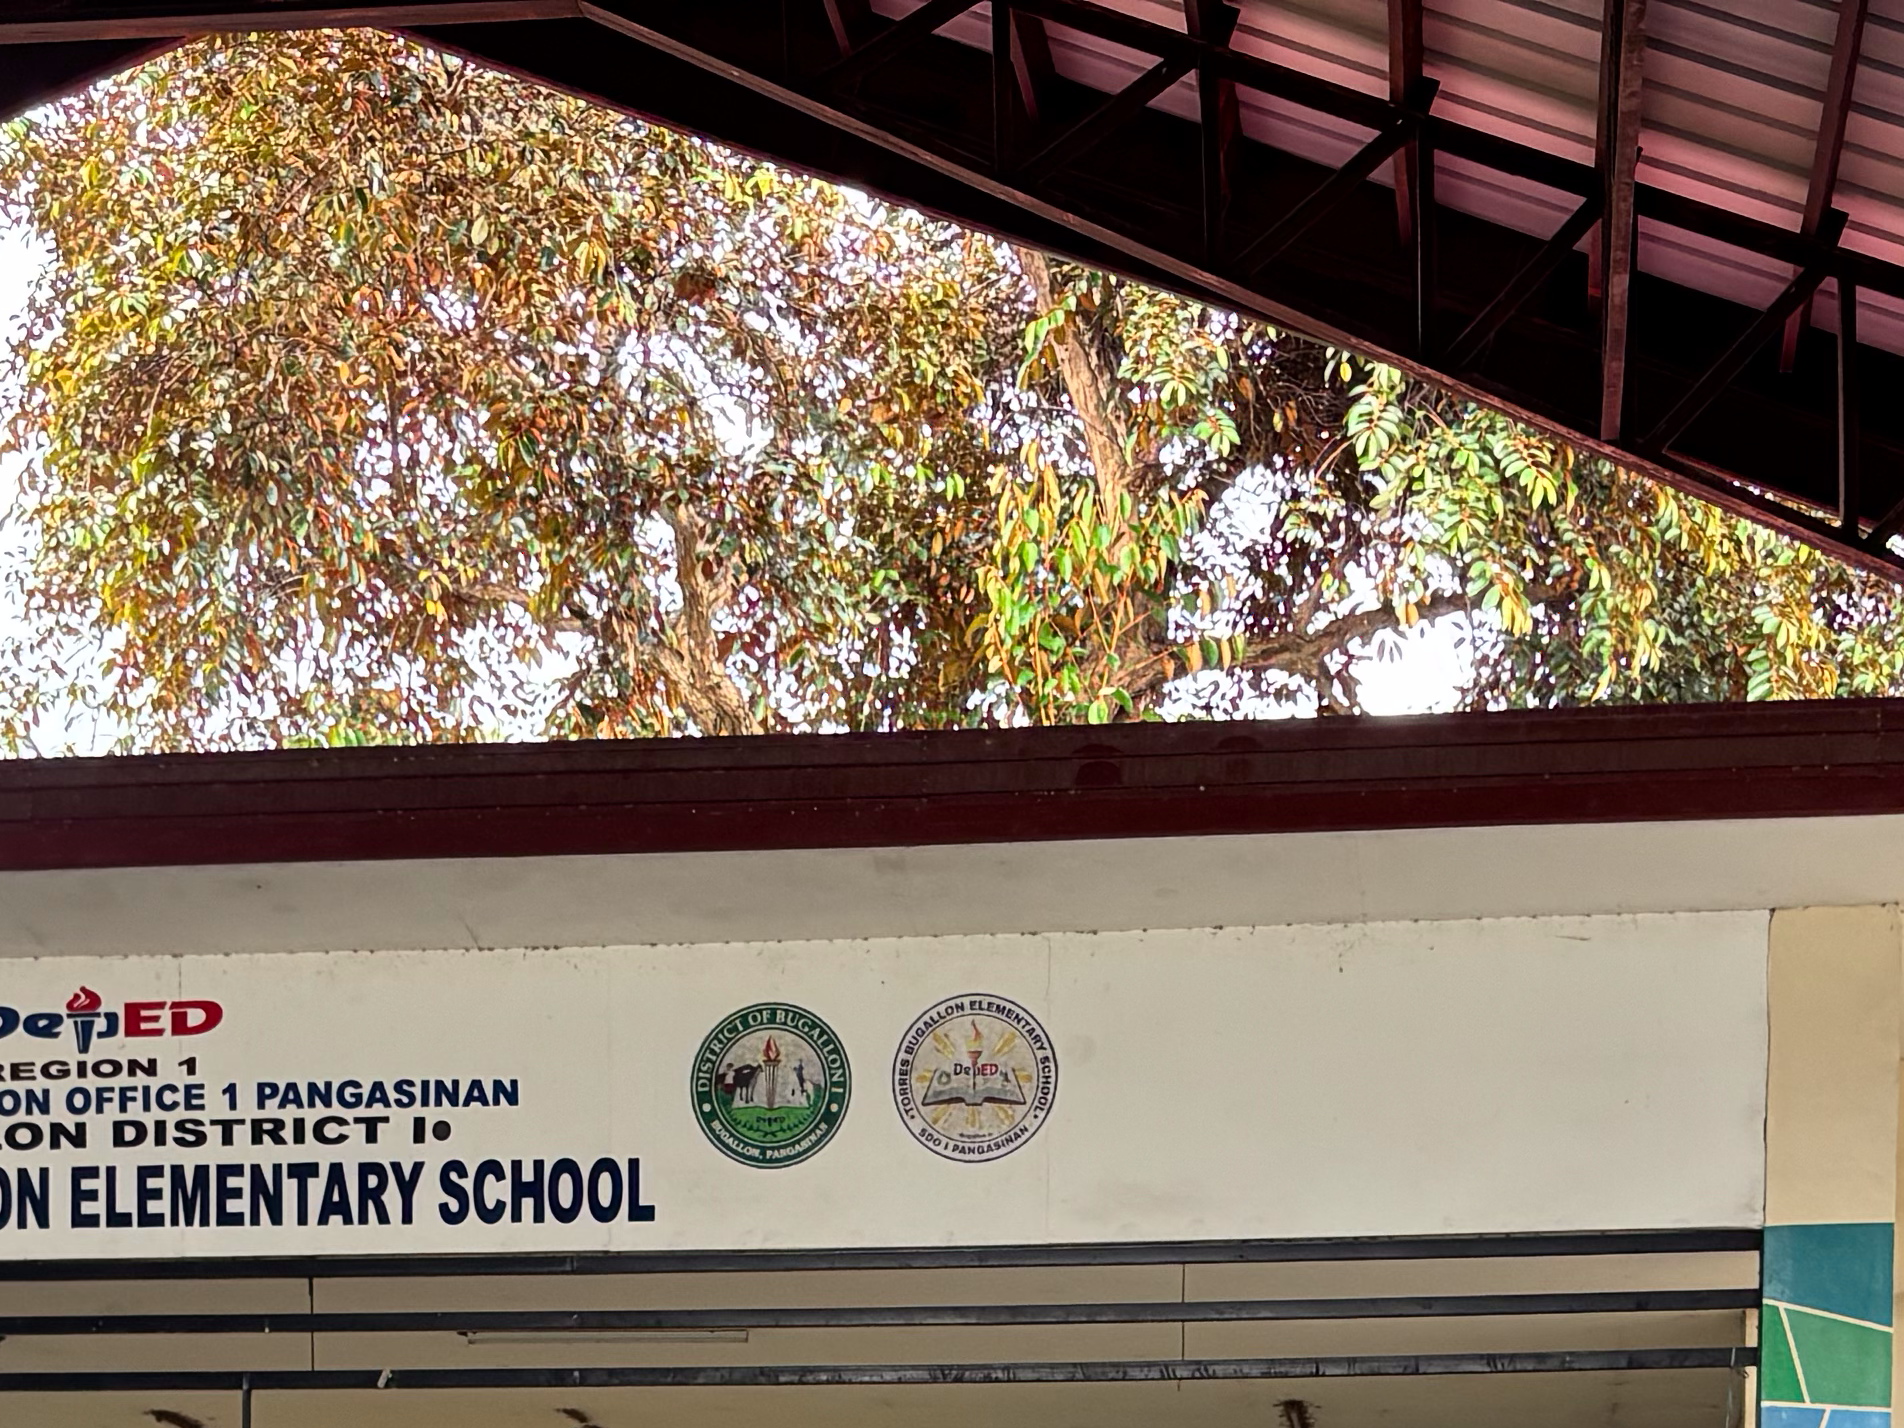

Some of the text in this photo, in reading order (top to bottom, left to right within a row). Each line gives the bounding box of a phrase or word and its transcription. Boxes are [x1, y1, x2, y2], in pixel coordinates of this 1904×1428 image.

[178, 1056, 197, 1077] 1
[697, 1018, 744, 1092] DISTRICT
[748, 1010, 771, 1026] OF
[776, 1009, 845, 1082] BUGALLON
[898, 1000, 1052, 1117] TORRES BUGALLON ELEMENTARY SCHOOL
[66, 1082, 206, 1116] OFFICE
[221, 1083, 238, 1110] 1
[256, 1078, 520, 1110] PANGASINAN
[112, 1115, 390, 1148] DISTRICT
[766, 1122, 828, 1159] PANGASINAN
[918, 1127, 942, 1147] SDO
[952, 1125, 1029, 1155] PANGASINAN
[70, 1161, 425, 1230] ELEMENTARY
[438, 1157, 656, 1226] SCHOOL
